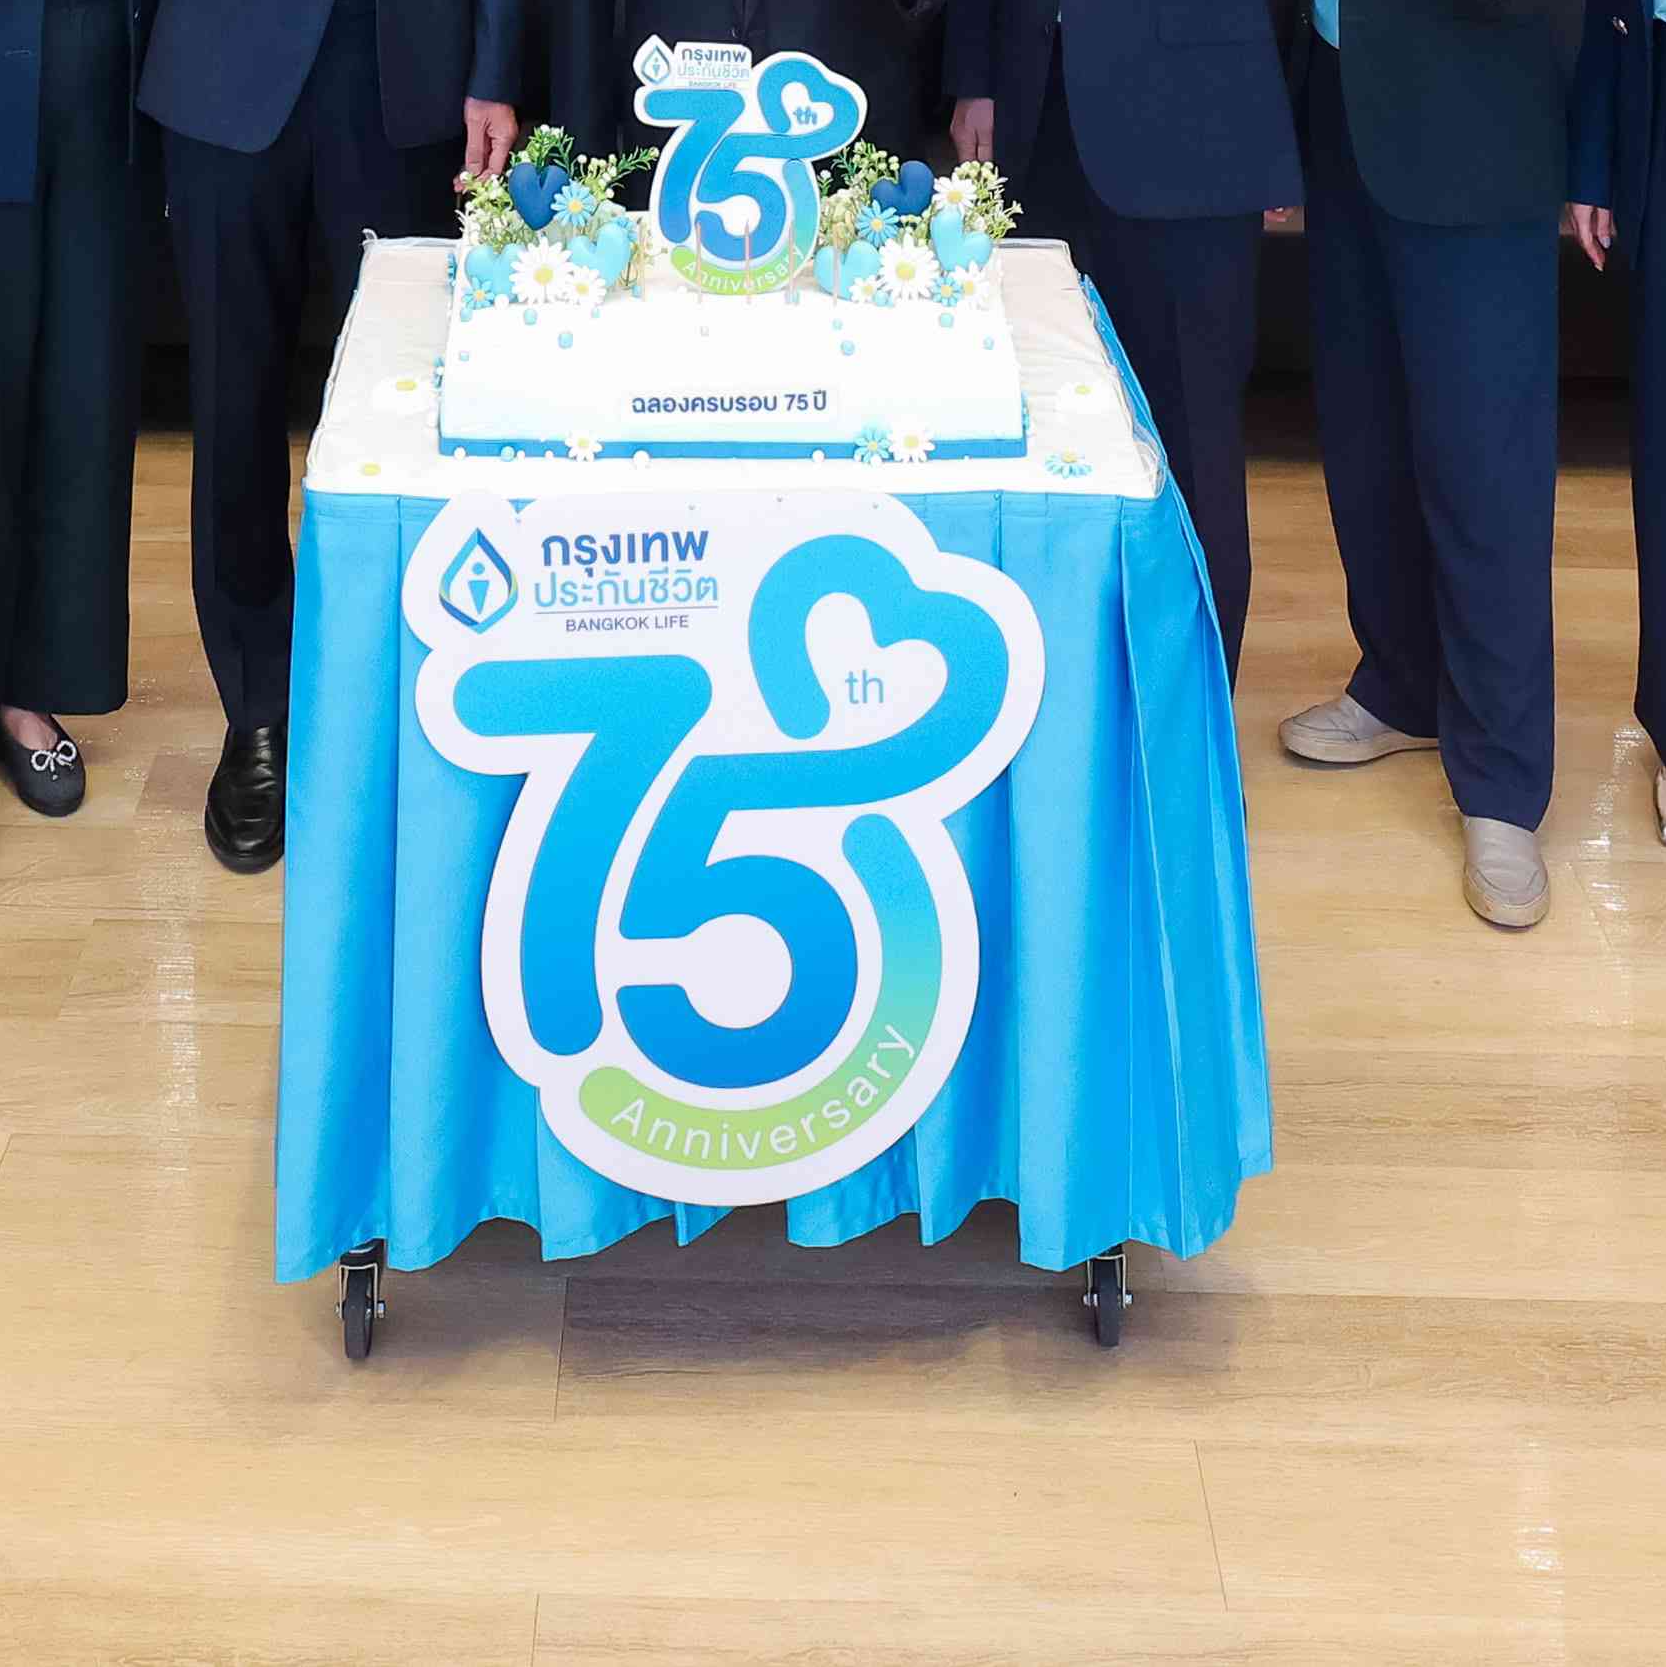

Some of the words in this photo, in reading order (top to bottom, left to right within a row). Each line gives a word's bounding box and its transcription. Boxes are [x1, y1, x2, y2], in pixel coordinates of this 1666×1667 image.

[681, 48, 747, 66] กรุงเทพ
[645, 58, 859, 261] 75
[793, 105, 818, 125] th
[632, 395, 778, 414] ฉลองครบรอบ
[784, 393, 809, 411] 75
[813, 389, 828, 411] ปี
[541, 530, 709, 578] กรุงเทพ
[534, 566, 719, 608] ประกันชีวิต
[565, 616, 650, 632] BANGKOK
[654, 614, 690, 629] LIFE
[453, 534, 1009, 1089] 75
[845, 671, 885, 704] th
[611, 1024, 916, 1161] Anniversary
